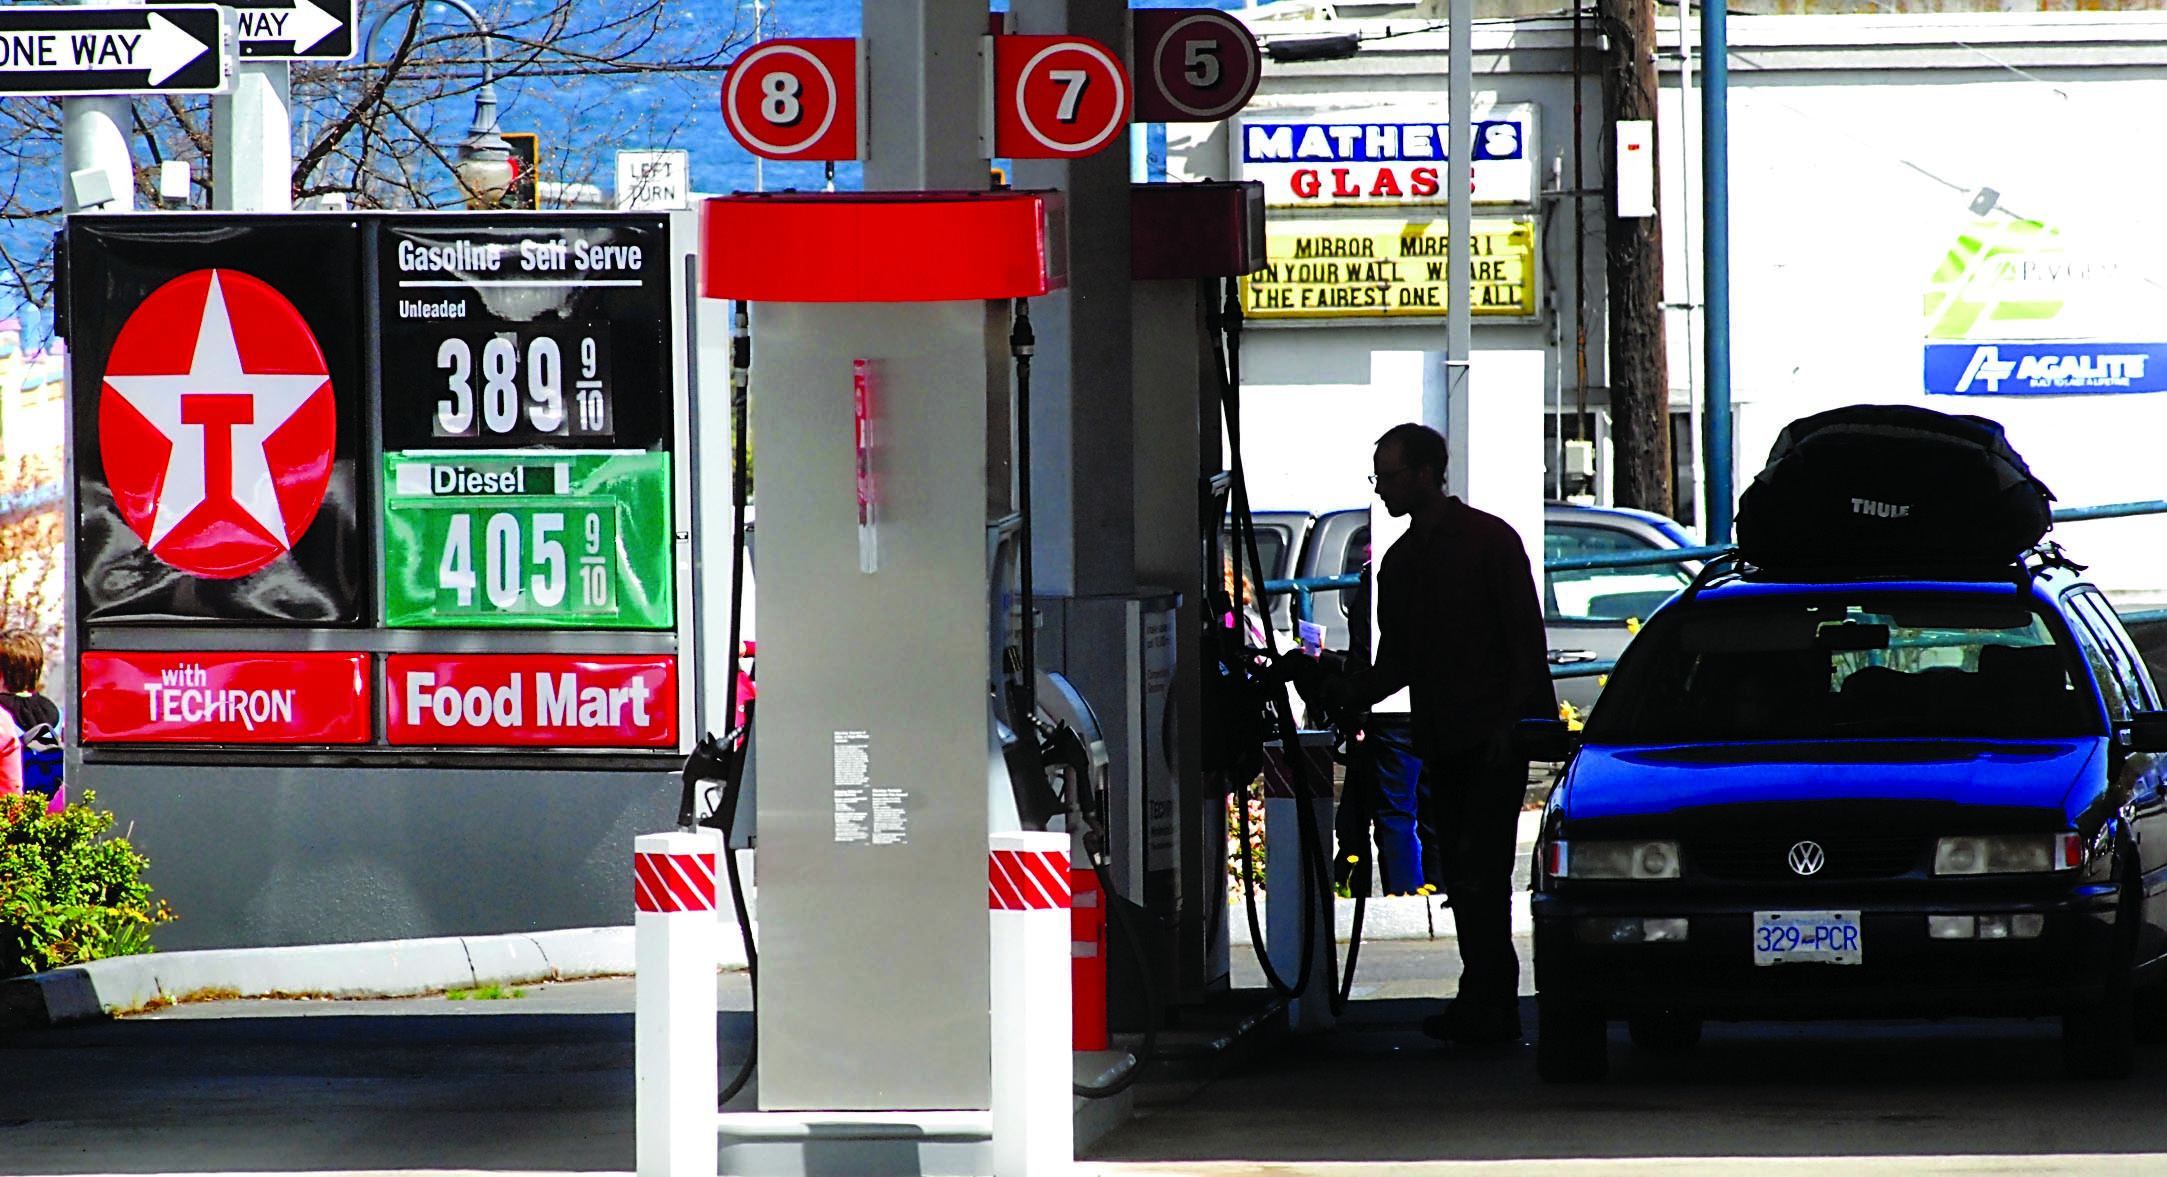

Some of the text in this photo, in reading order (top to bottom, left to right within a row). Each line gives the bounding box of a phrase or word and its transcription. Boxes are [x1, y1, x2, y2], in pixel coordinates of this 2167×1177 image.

[0, 34, 142, 67] ONE WAY
[1184, 40, 1220, 87] 5
[761, 72, 803, 124] 8
[1049, 70, 1088, 122] 7
[631, 162, 671, 179] LEFT
[1290, 167, 1475, 198] GLAS
[629, 185, 675, 202] TURN
[398, 239, 642, 271] Gasoline Self Serve
[1295, 237, 1374, 258] MIRROR
[1252, 263, 1278, 283] ON
[1285, 263, 1339, 283] YOUR
[1346, 262, 1405, 282] WALL
[399, 299, 466, 318] Unleaded
[1251, 287, 1294, 308] THE
[1301, 287, 1391, 307] FAIREST
[1400, 286, 1440, 306] ONE
[1482, 285, 1522, 305] ALL
[2016, 354, 2149, 380] AGALITE
[437, 337, 563, 433] 389
[434, 465, 524, 493] Diesel
[1851, 498, 1910, 518] THULE
[439, 512, 566, 607] 405
[161, 663, 207, 687] with
[144, 683, 293, 731] TECHRON
[407, 672, 650, 727] Food Mart
[1757, 926, 1858, 952] 329-PCR
